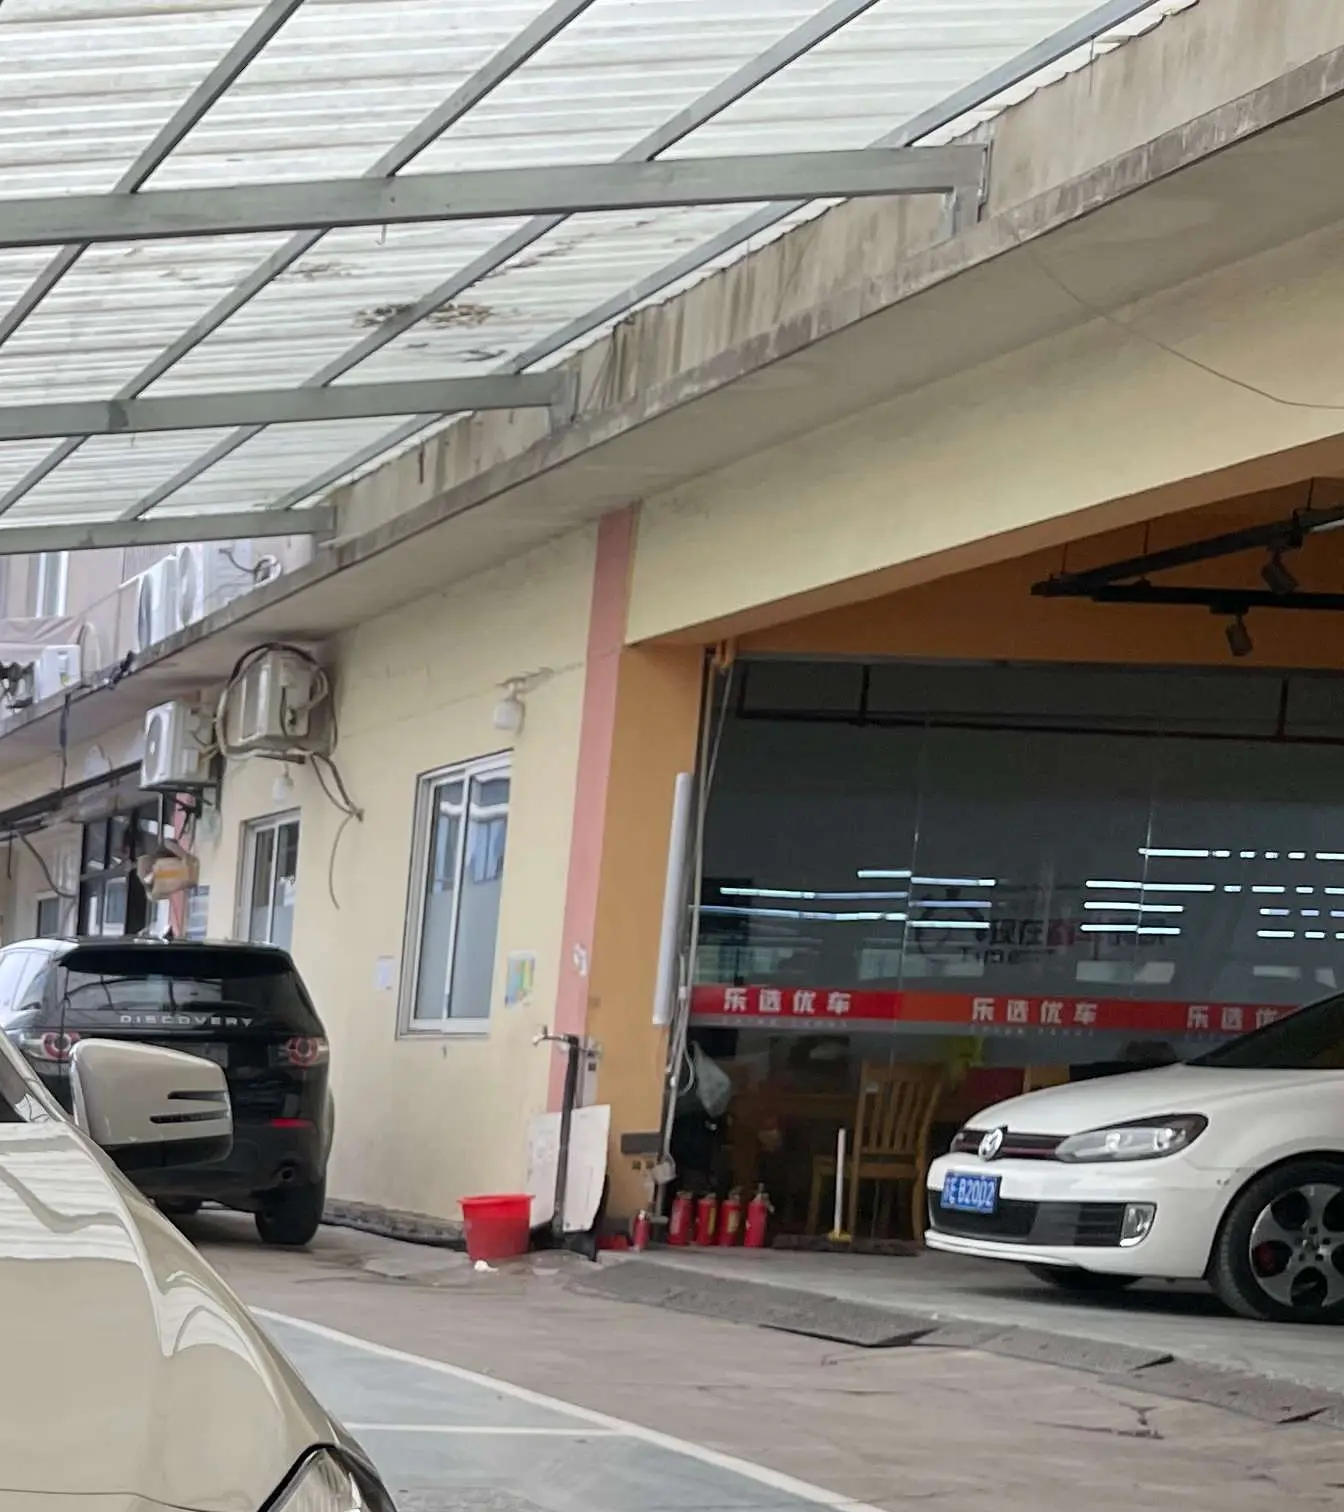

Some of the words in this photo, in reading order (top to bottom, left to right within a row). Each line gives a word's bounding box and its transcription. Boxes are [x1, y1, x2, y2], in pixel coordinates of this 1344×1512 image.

[723, 987, 852, 1015] 乐选优车
[972, 997, 1098, 1025] 乐选优车
[120, 1015, 253, 1027] DISCOVERY
